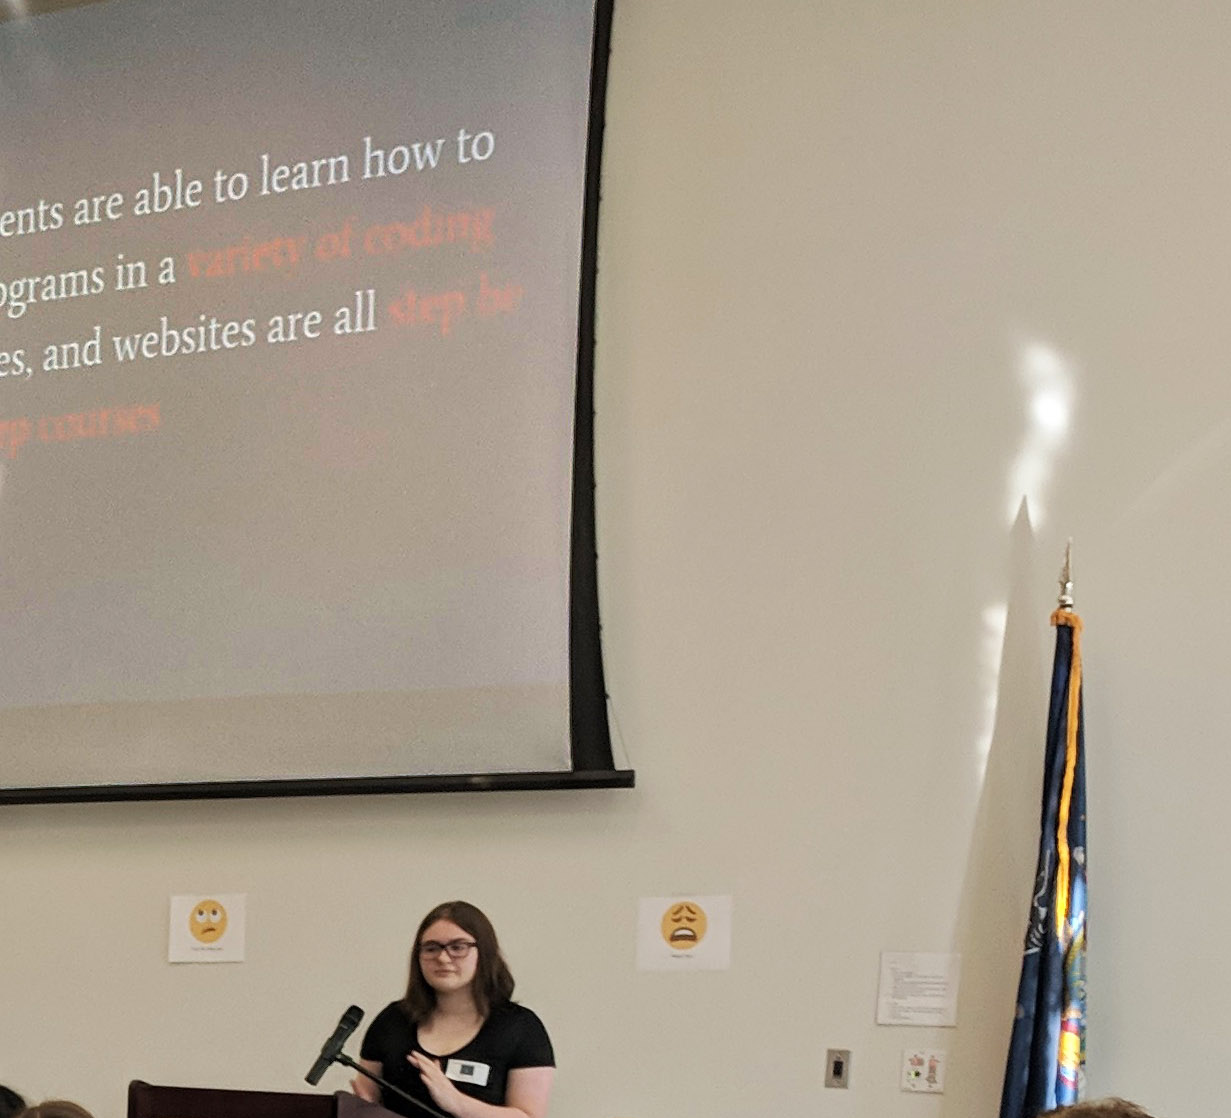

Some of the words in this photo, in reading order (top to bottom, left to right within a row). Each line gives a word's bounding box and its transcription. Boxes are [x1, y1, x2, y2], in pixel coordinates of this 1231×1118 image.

[74, 192, 124, 226] are
[134, 169, 203, 216] able
[214, 170, 249, 203] to
[261, 154, 351, 196] learn
[362, 136, 445, 180] how
[457, 128, 495, 164] to
[115, 254, 149, 290] in
[158, 256, 176, 284] a
[43, 326, 103, 372] and
[112, 314, 257, 362] websites
[267, 309, 323, 344] are
[334, 289, 378, 335] all
